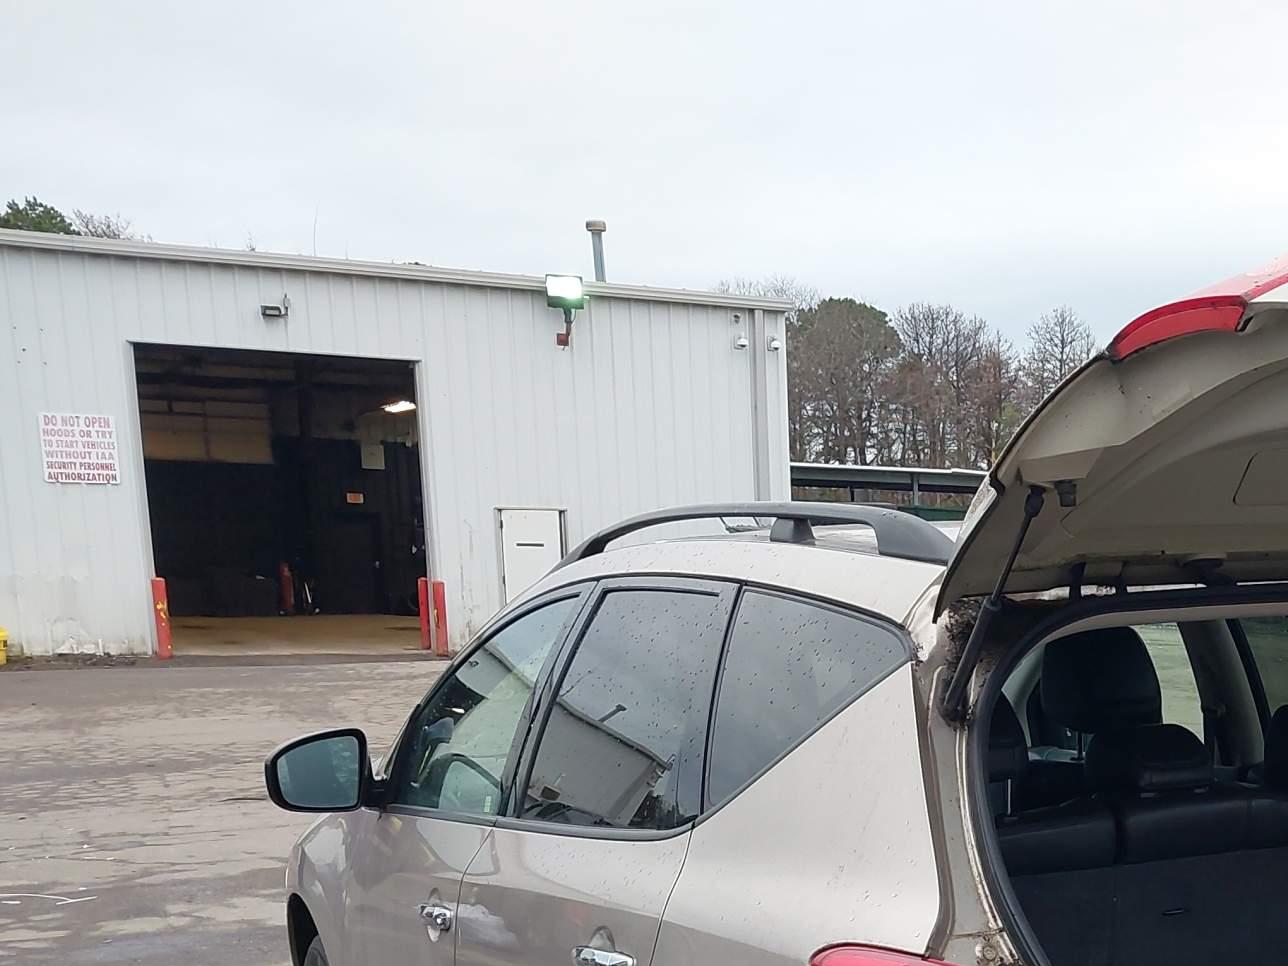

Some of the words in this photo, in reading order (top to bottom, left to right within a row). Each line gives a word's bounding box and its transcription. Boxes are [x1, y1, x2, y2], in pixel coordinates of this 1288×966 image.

[43, 415, 58, 427] DO
[61, 415, 80, 427] NOT
[84, 416, 110, 428] OPEN
[42, 428, 76, 438] HOODS
[79, 429, 92, 438] OR
[95, 430, 113, 439] TRY
[43, 439, 53, 448] TO
[55, 439, 78, 449] START
[81, 440, 115, 450] VEHICLES
[45, 450, 92, 460] WITHOUT
[96, 451, 114, 460] IAA
[46, 461, 77, 470] SECURITY
[79, 462, 116, 471] PERSONNEL
[47, 471, 117, 482] AUTHORIZATION
